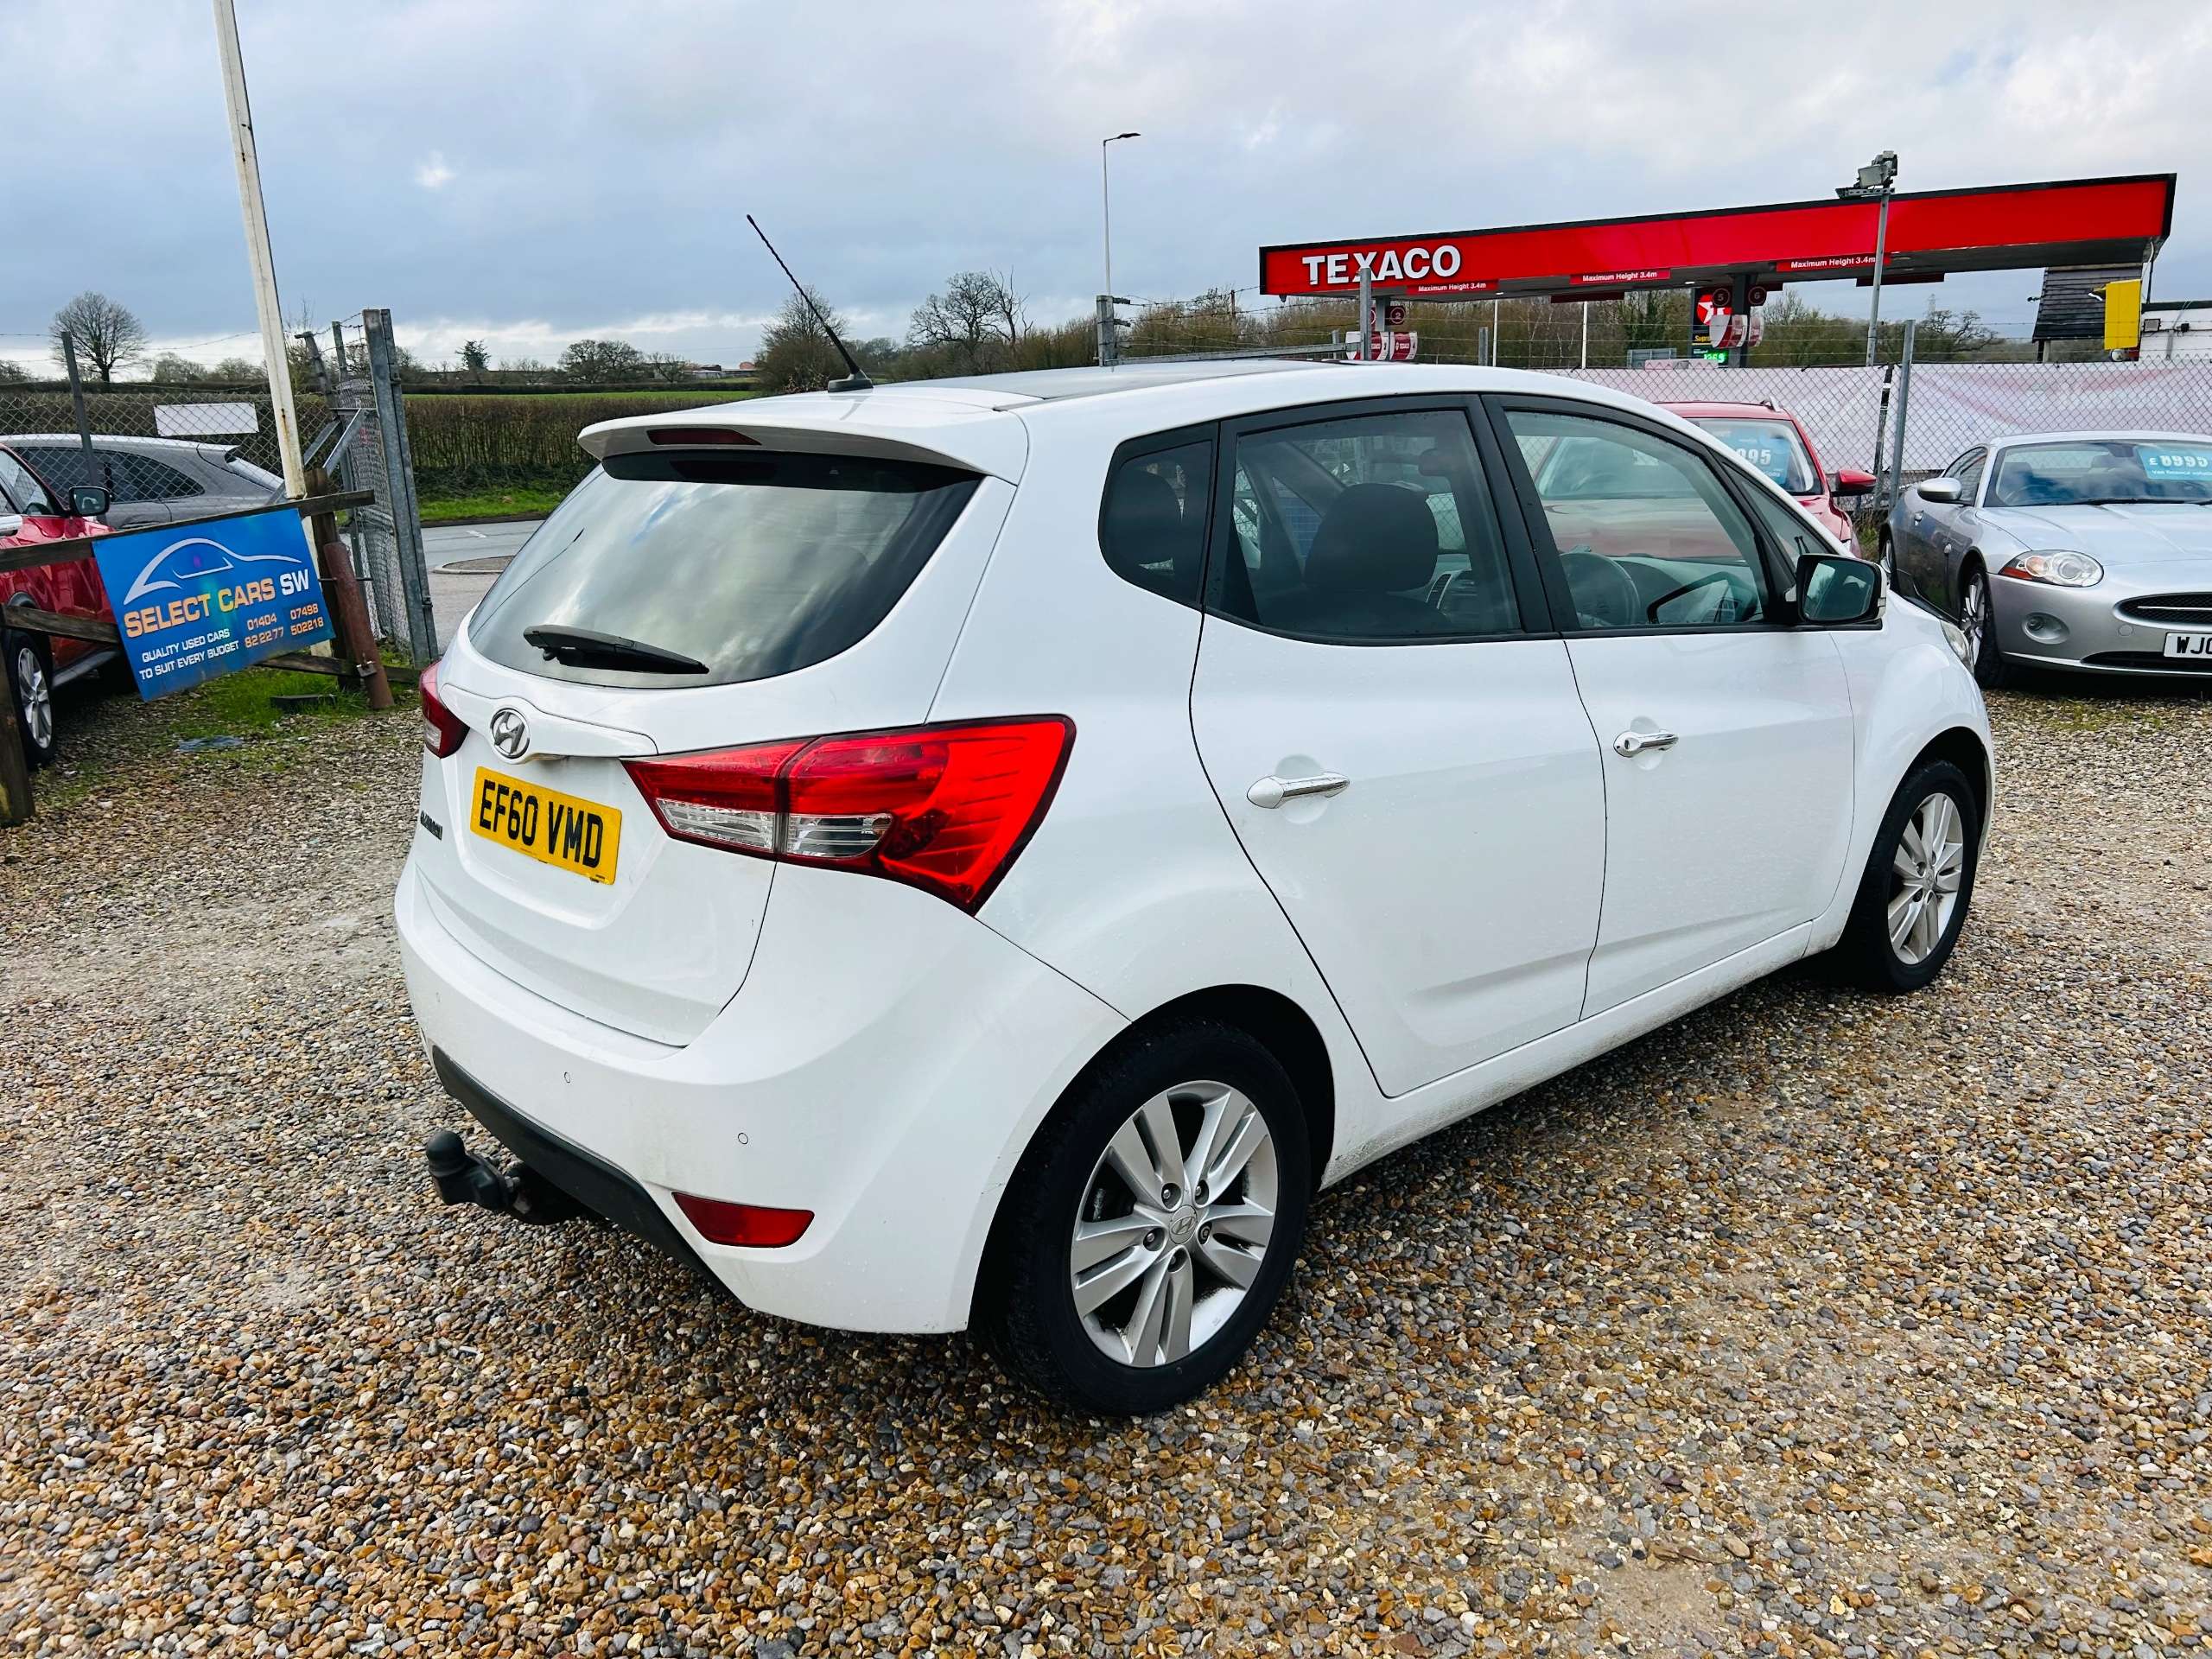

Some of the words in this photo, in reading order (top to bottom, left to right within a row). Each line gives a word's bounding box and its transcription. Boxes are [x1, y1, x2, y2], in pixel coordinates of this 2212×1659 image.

[1302, 245, 1461, 285] TEXACO
[1828, 258, 1854, 267] Height
[1616, 272, 1638, 281] Height
[1418, 284, 1447, 293] Maximum
[1448, 283, 1470, 292] Height
[124, 594, 212, 638] SELECT
[217, 578, 275, 613] CARS
[279, 569, 310, 595] SW
[290, 603, 319, 620] 07498
[246, 613, 276, 631] 01404
[290, 617, 324, 636] 502218
[142, 642, 181, 663] QUALITY
[181, 635, 206, 651] USED
[207, 628, 231, 644] CARS
[139, 668, 154, 681] TO
[154, 662, 175, 678] SUIT
[176, 652, 206, 671] EVERY
[207, 640, 239, 660] BUDGET
[479, 779, 539, 847] EF60
[548, 800, 603, 868] VMD
